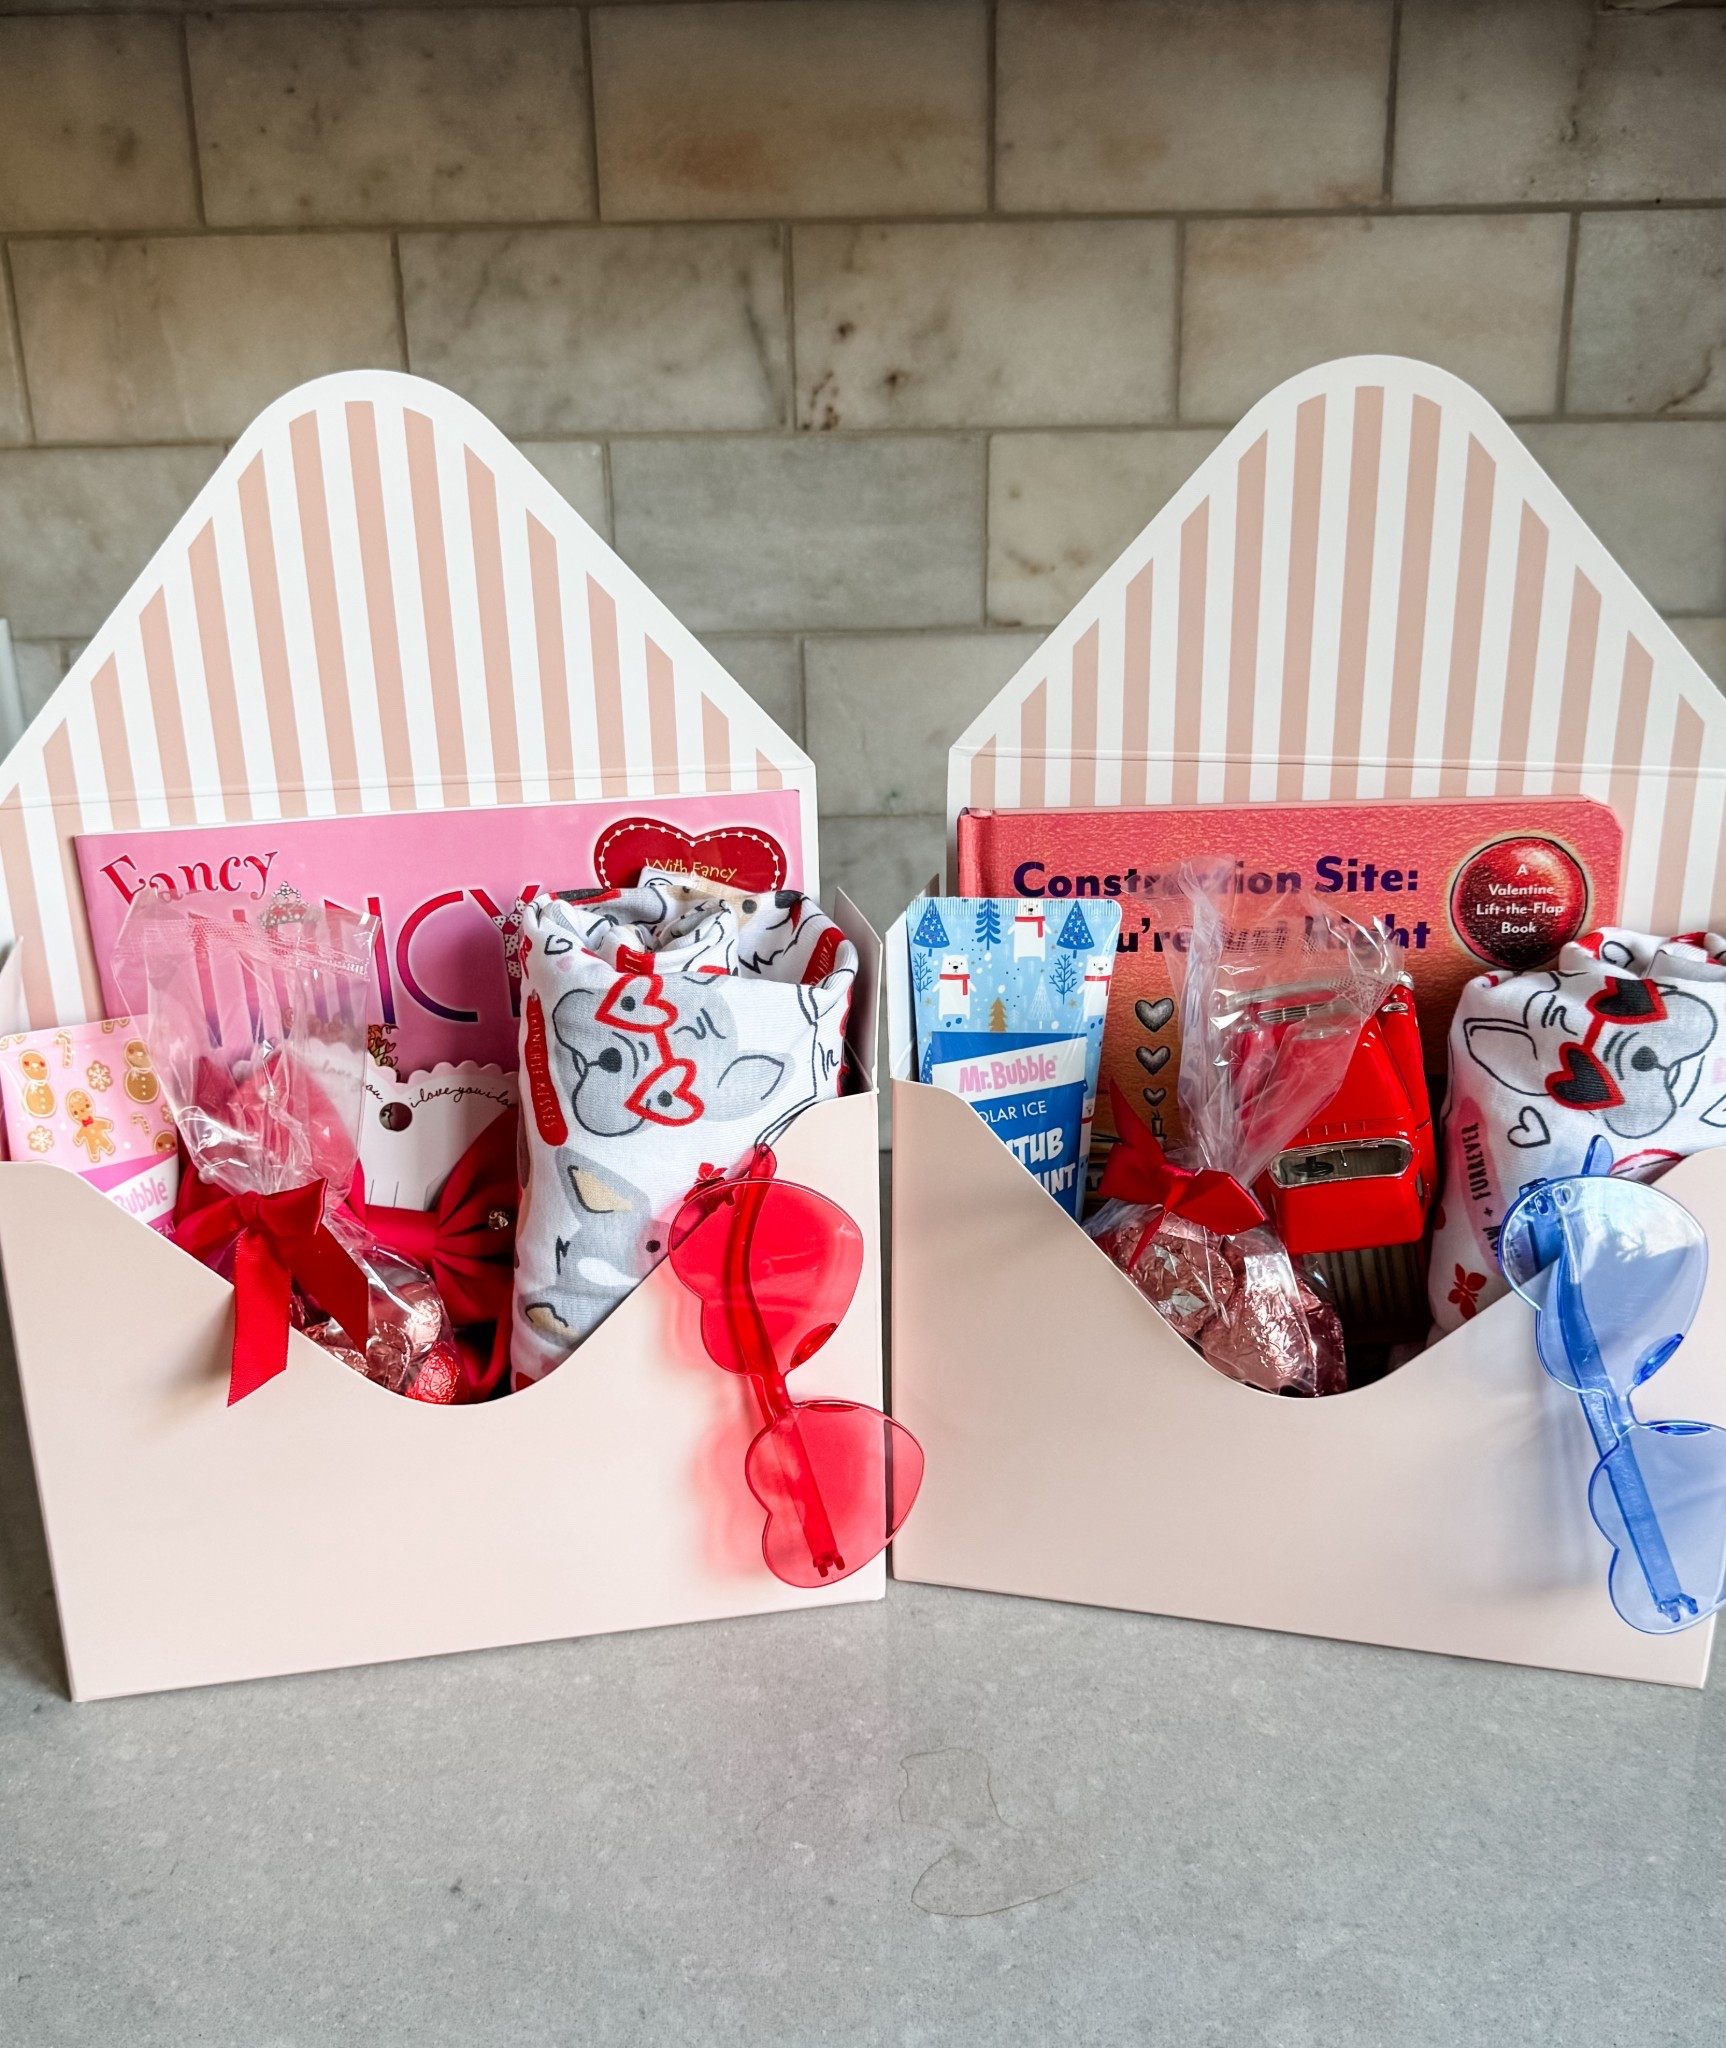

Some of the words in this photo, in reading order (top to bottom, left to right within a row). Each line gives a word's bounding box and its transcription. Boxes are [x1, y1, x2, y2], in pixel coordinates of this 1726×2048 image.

[100, 851, 278, 905] Fancy
[645, 858, 688, 874] With
[693, 861, 738, 882] Fancy
[1013, 861, 1301, 898] Constrution
[1315, 855, 1418, 893] Site:
[1516, 864, 1528, 876] A
[1488, 883, 1555, 896] Valentine
[1476, 902, 1565, 916] Lift-the-Flap
[1501, 921, 1537, 934] Book
[978, 1106, 1018, 1124] OLAR
[1022, 1100, 1048, 1118] ICE
[1461, 1122, 1492, 1201] FURREVER
